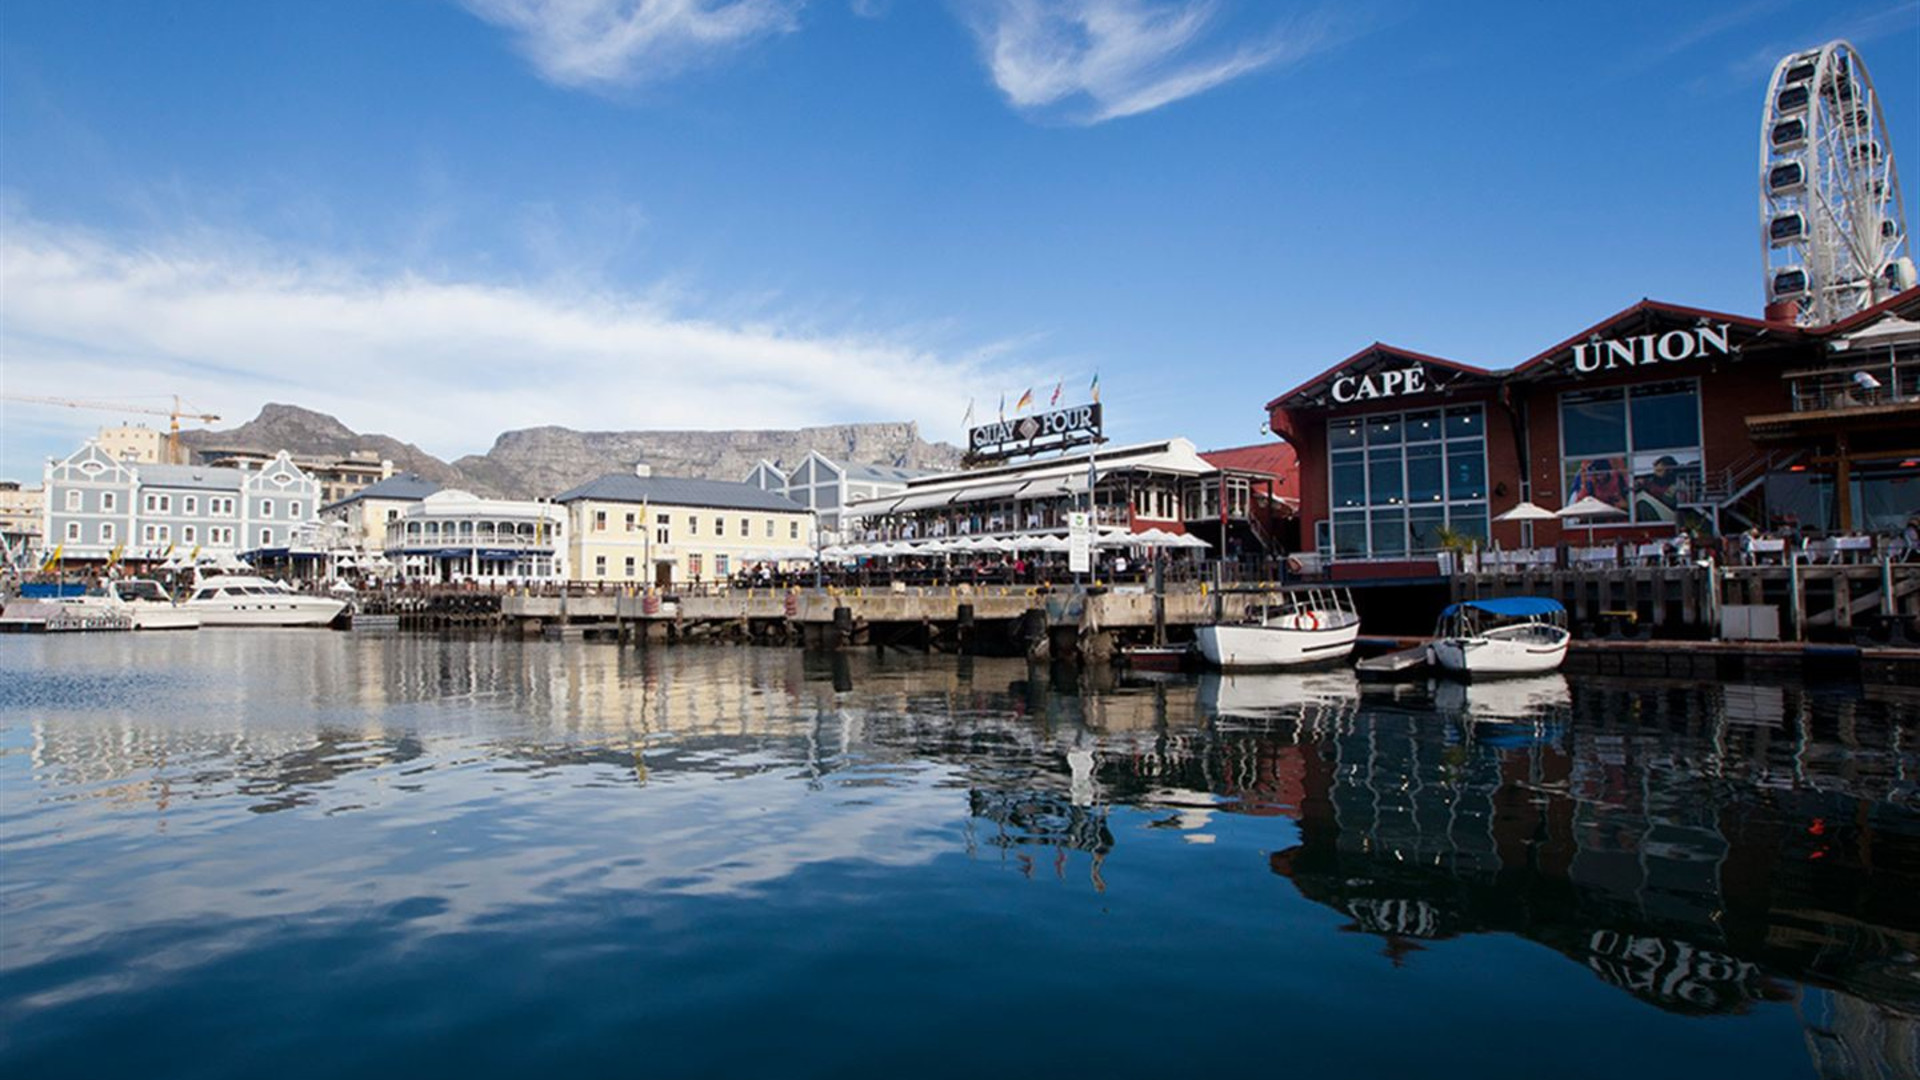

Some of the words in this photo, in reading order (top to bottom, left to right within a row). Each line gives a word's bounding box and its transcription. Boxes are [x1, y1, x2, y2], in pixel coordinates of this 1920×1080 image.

[1331, 367, 1426, 402] CAPE
[1571, 323, 1731, 372] UNION
[973, 421, 1016, 446] QUAY
[1042, 406, 1092, 434] FOUR
